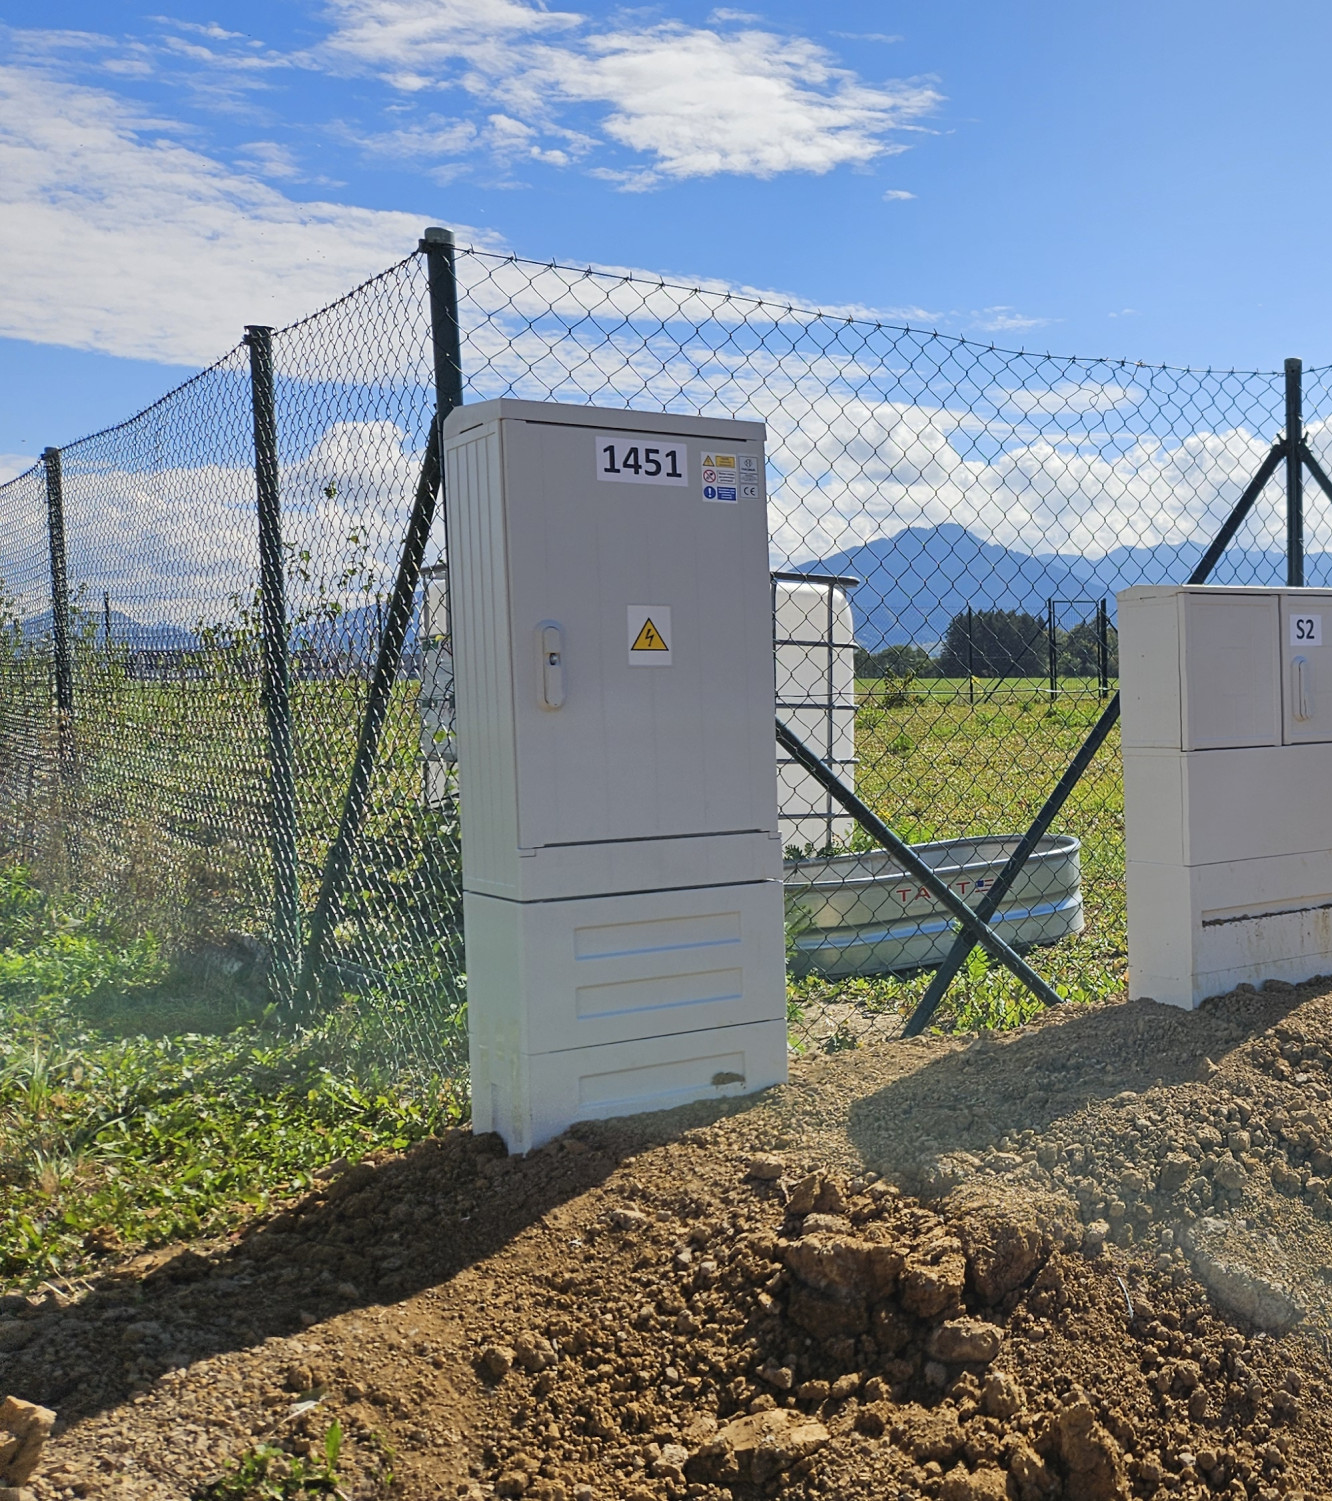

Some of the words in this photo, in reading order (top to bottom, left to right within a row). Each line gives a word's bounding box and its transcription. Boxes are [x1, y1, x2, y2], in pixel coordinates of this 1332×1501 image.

[603, 445, 682, 478] 1451
[1296, 618, 1315, 640] S2
[896, 879, 1013, 903] TATE
